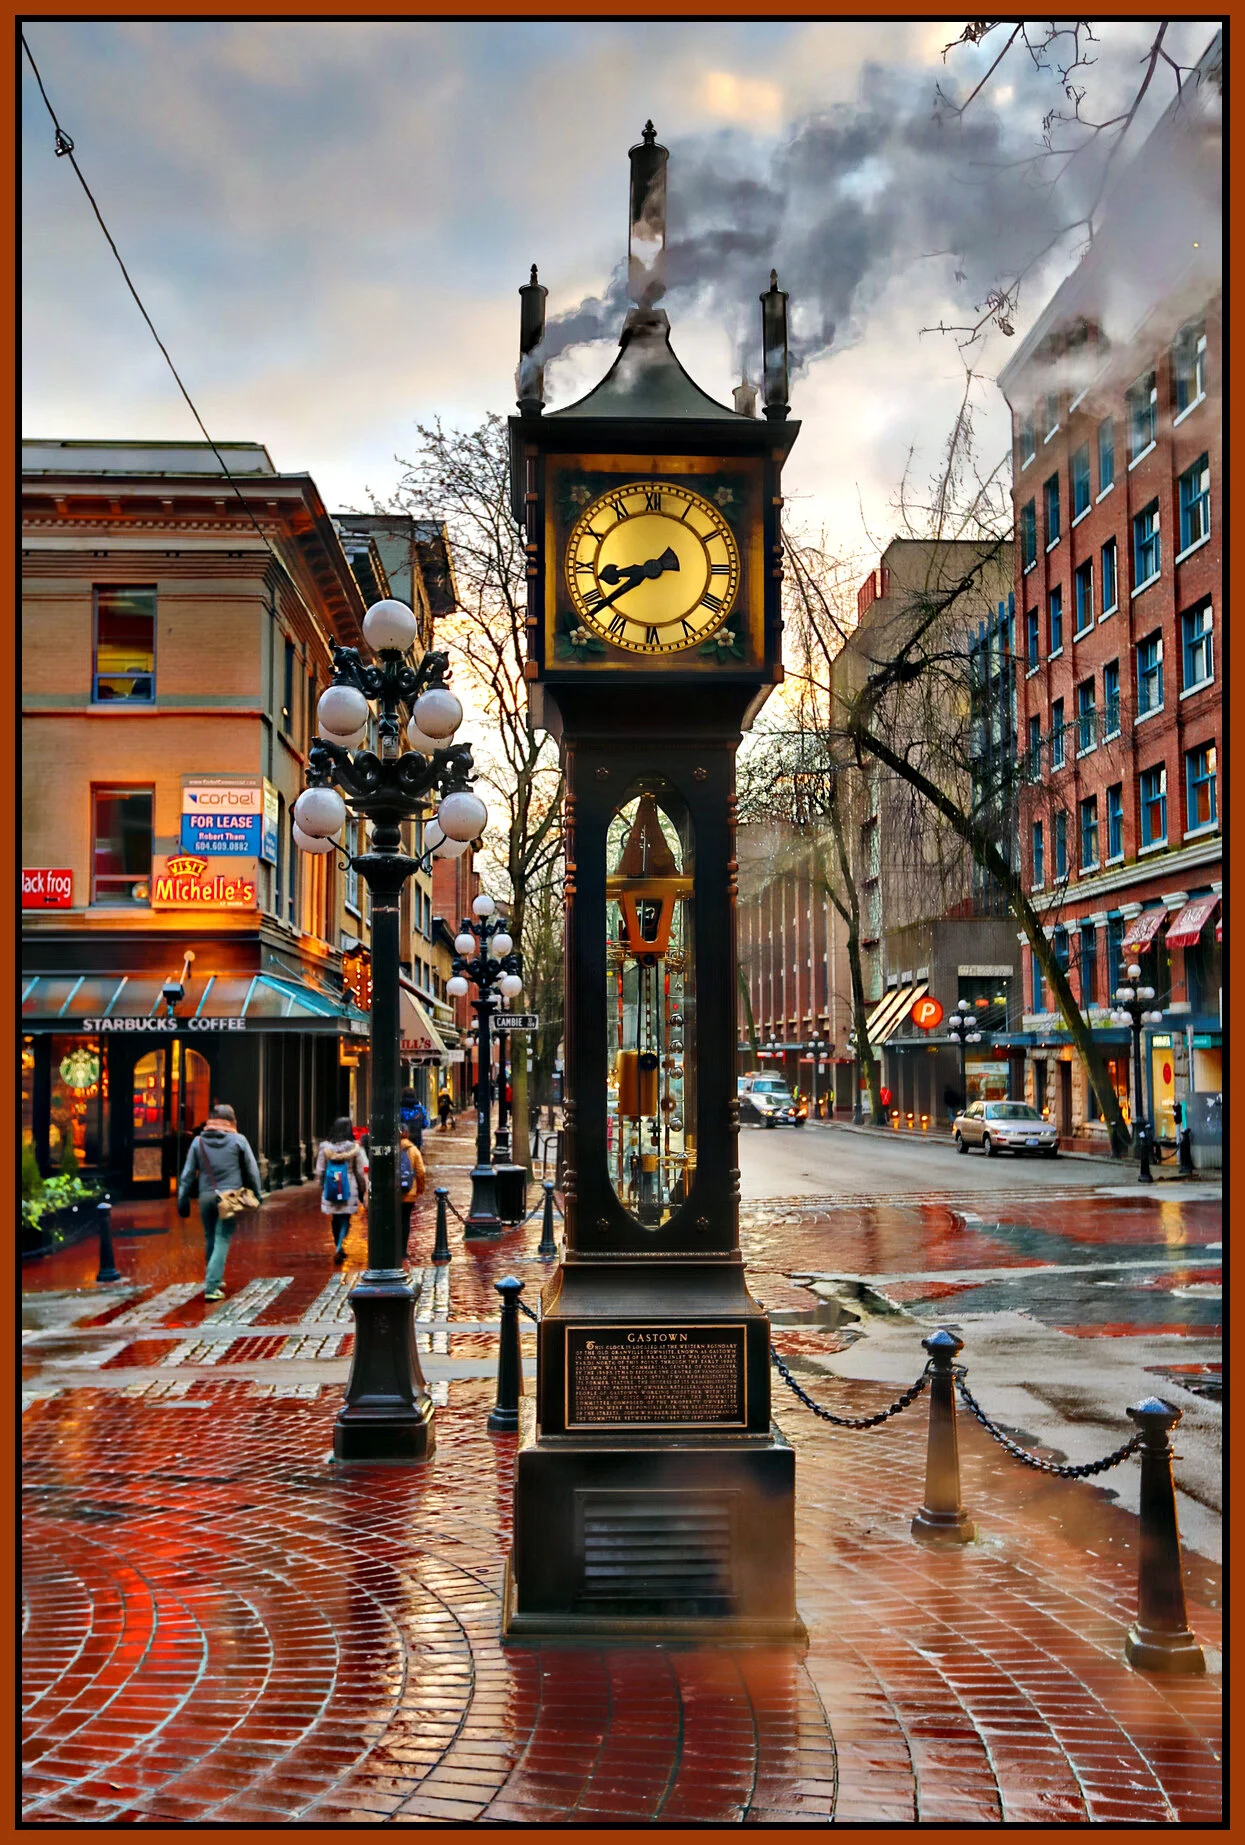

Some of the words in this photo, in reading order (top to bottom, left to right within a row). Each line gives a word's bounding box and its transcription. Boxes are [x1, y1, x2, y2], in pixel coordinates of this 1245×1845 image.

[199, 791, 255, 805] corbel
[190, 816, 214, 828] FOR
[217, 816, 253, 828] LEASE
[198, 832, 224, 840] Robert
[170, 860, 207, 874] VISIT
[47, 870, 71, 898] frog
[156, 878, 253, 901] Michelle's
[920, 1002, 936, 1023] P
[82, 1018, 178, 1031] STARBUCKS
[188, 1018, 246, 1031] COFFEE
[496, 1017, 523, 1027] CAMBIE
[628, 1333, 688, 1342] GASTOWN
